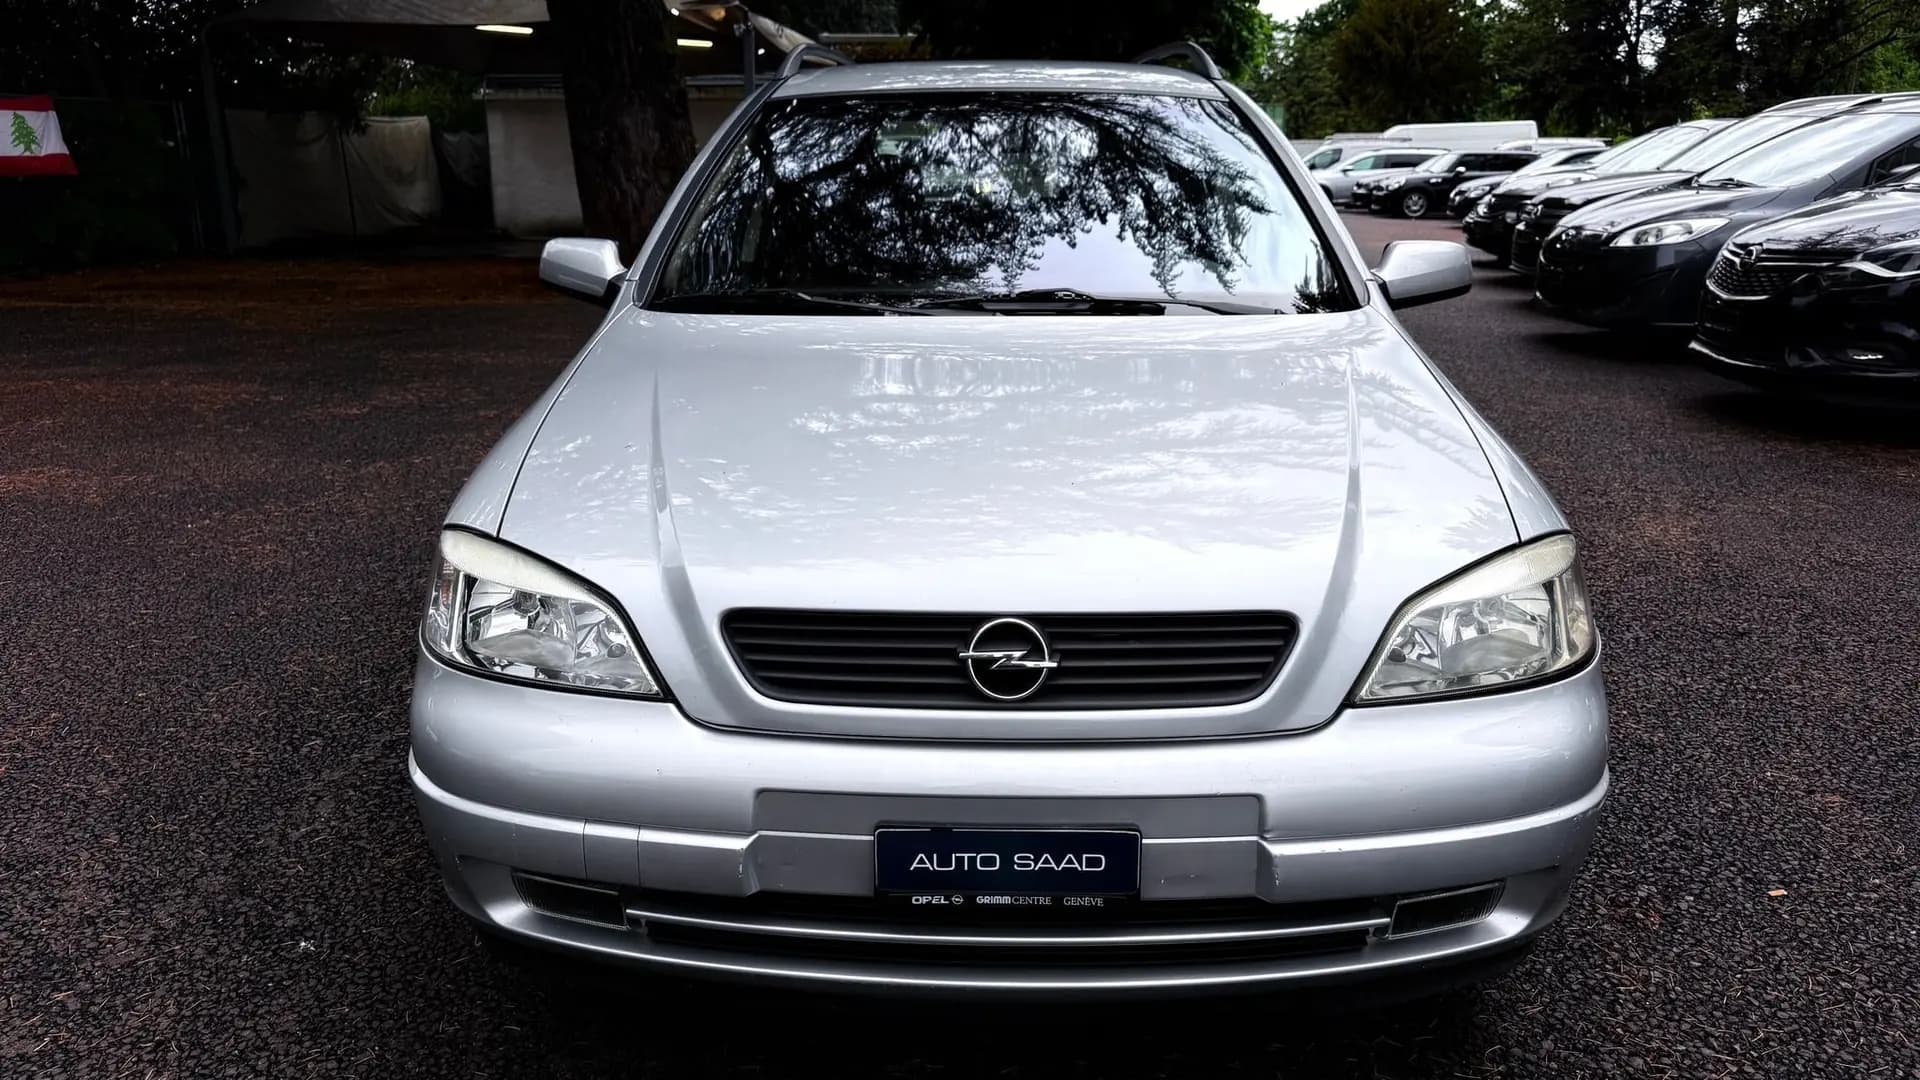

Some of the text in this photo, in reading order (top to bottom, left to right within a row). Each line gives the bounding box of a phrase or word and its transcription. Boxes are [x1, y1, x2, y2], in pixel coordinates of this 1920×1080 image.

[909, 852, 1106, 872] AUTO SAAD
[911, 895, 950, 905] OPEL
